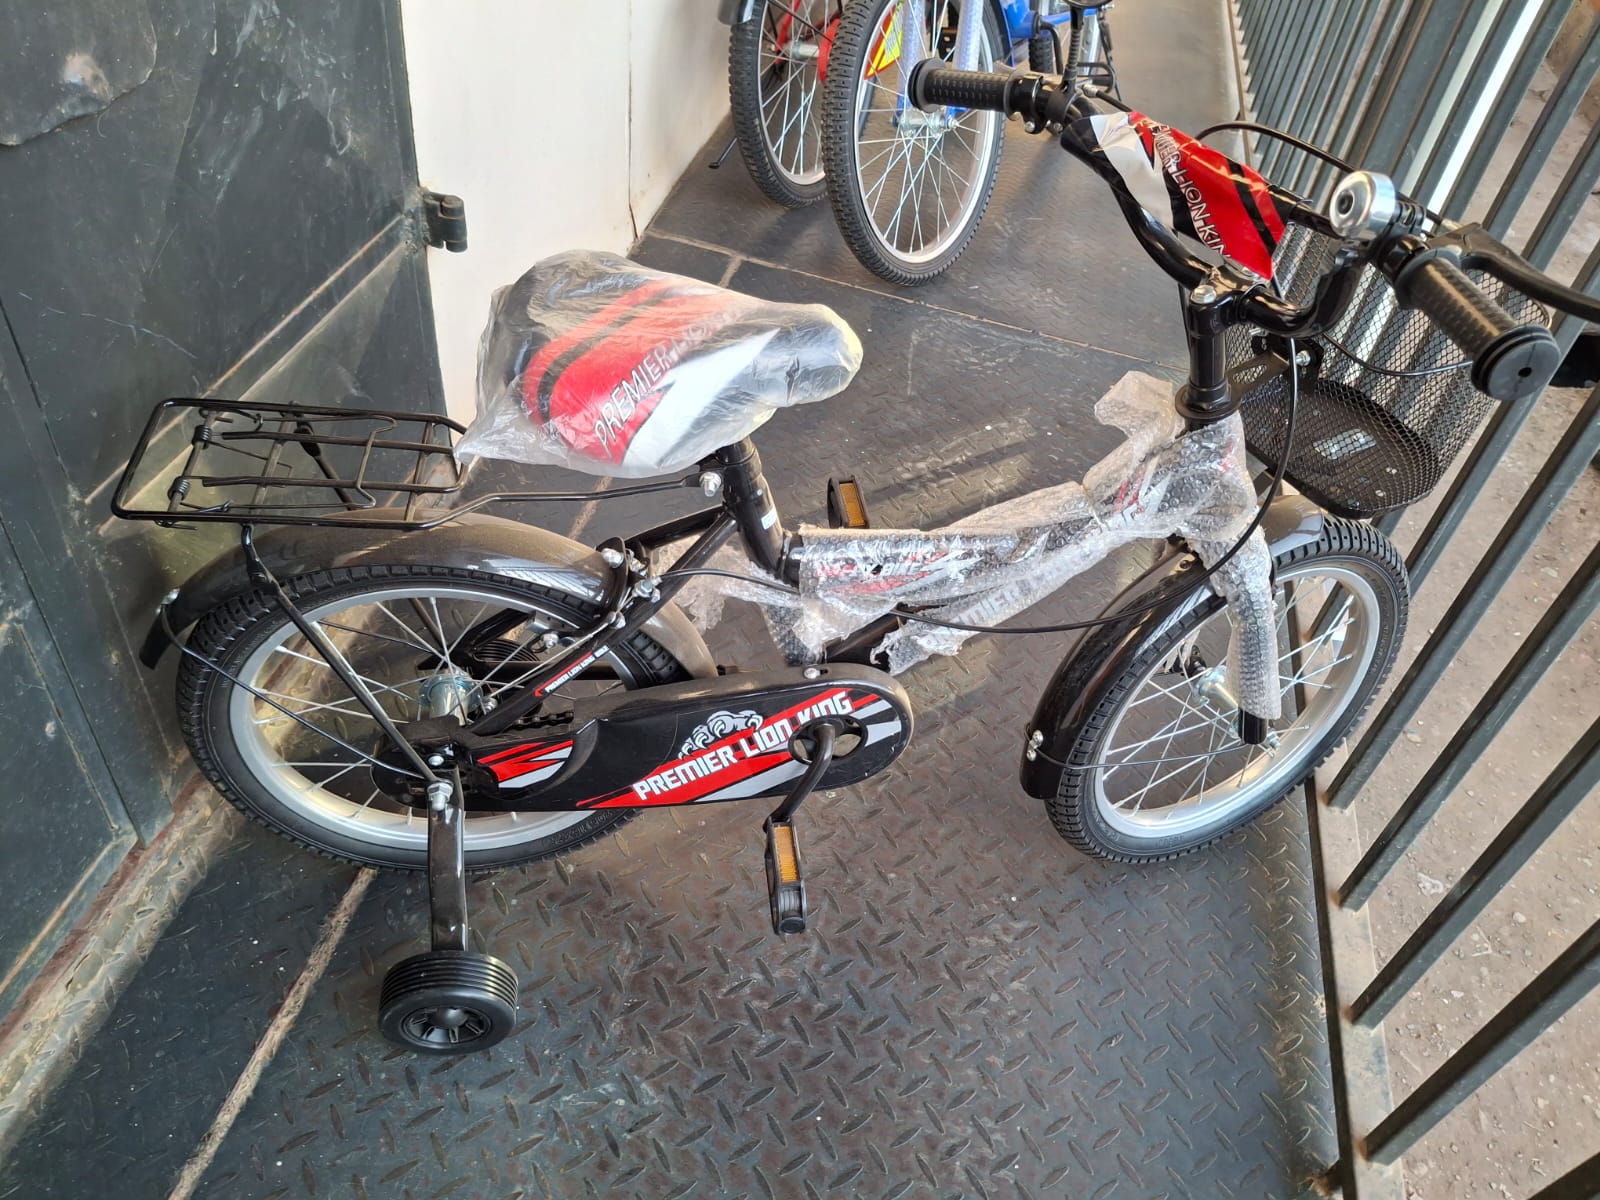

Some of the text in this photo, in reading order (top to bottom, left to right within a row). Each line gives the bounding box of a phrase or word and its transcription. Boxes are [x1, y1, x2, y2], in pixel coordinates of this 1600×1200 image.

[1145, 121, 1232, 257] EMIER LION KIN
[594, 343, 675, 459] PREMIER
[632, 691, 854, 800] PREMIER LION KING
